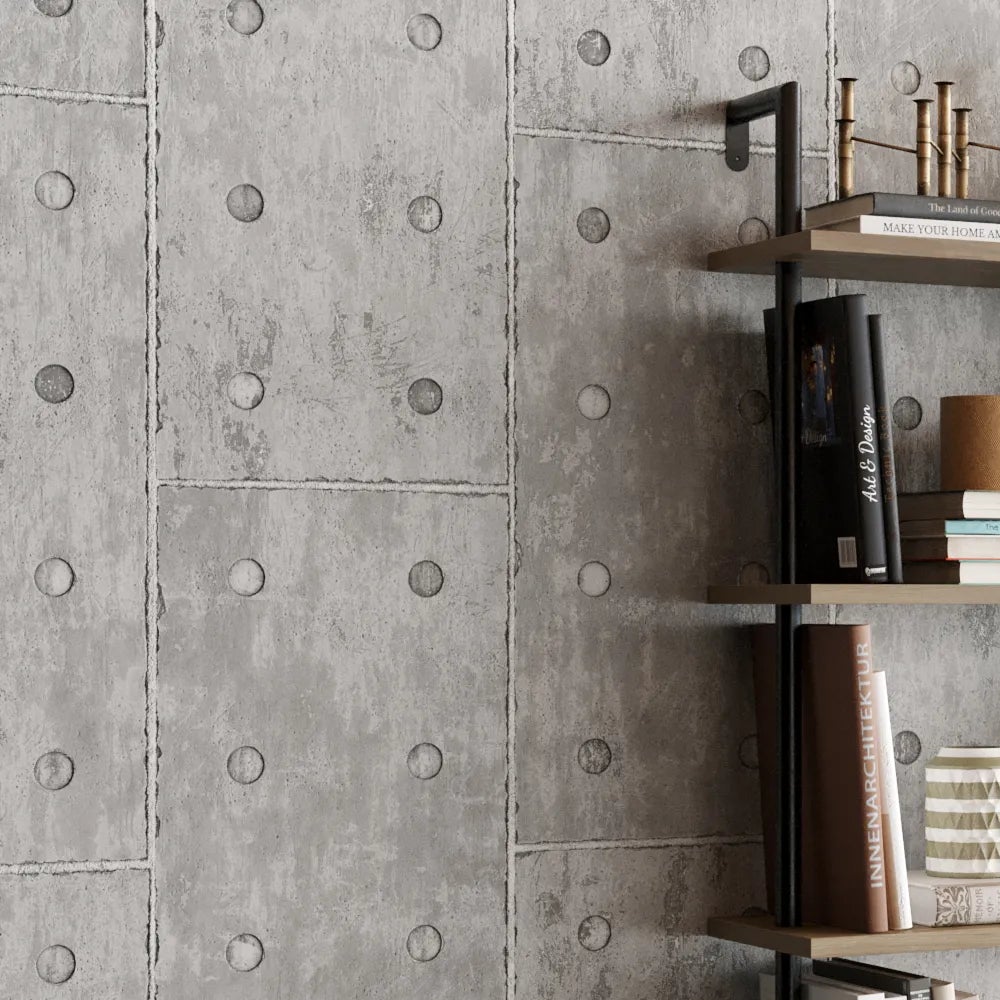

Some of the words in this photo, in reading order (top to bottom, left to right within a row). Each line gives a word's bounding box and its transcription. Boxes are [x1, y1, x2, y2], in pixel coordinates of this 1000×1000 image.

[928, 202, 945, 214] The
[947, 203, 968, 215] Land
[970, 205, 979, 216] of
[883, 222, 915, 234] MAKE
[918, 224, 950, 237] YOUR
[951, 226, 985, 239] HOME
[858, 404, 876, 454] Design
[859, 459, 877, 473] &
[861, 475, 878, 503] Art
[985, 523, 999, 532] The
[857, 642, 884, 889] INNENARCHITEKTUR
